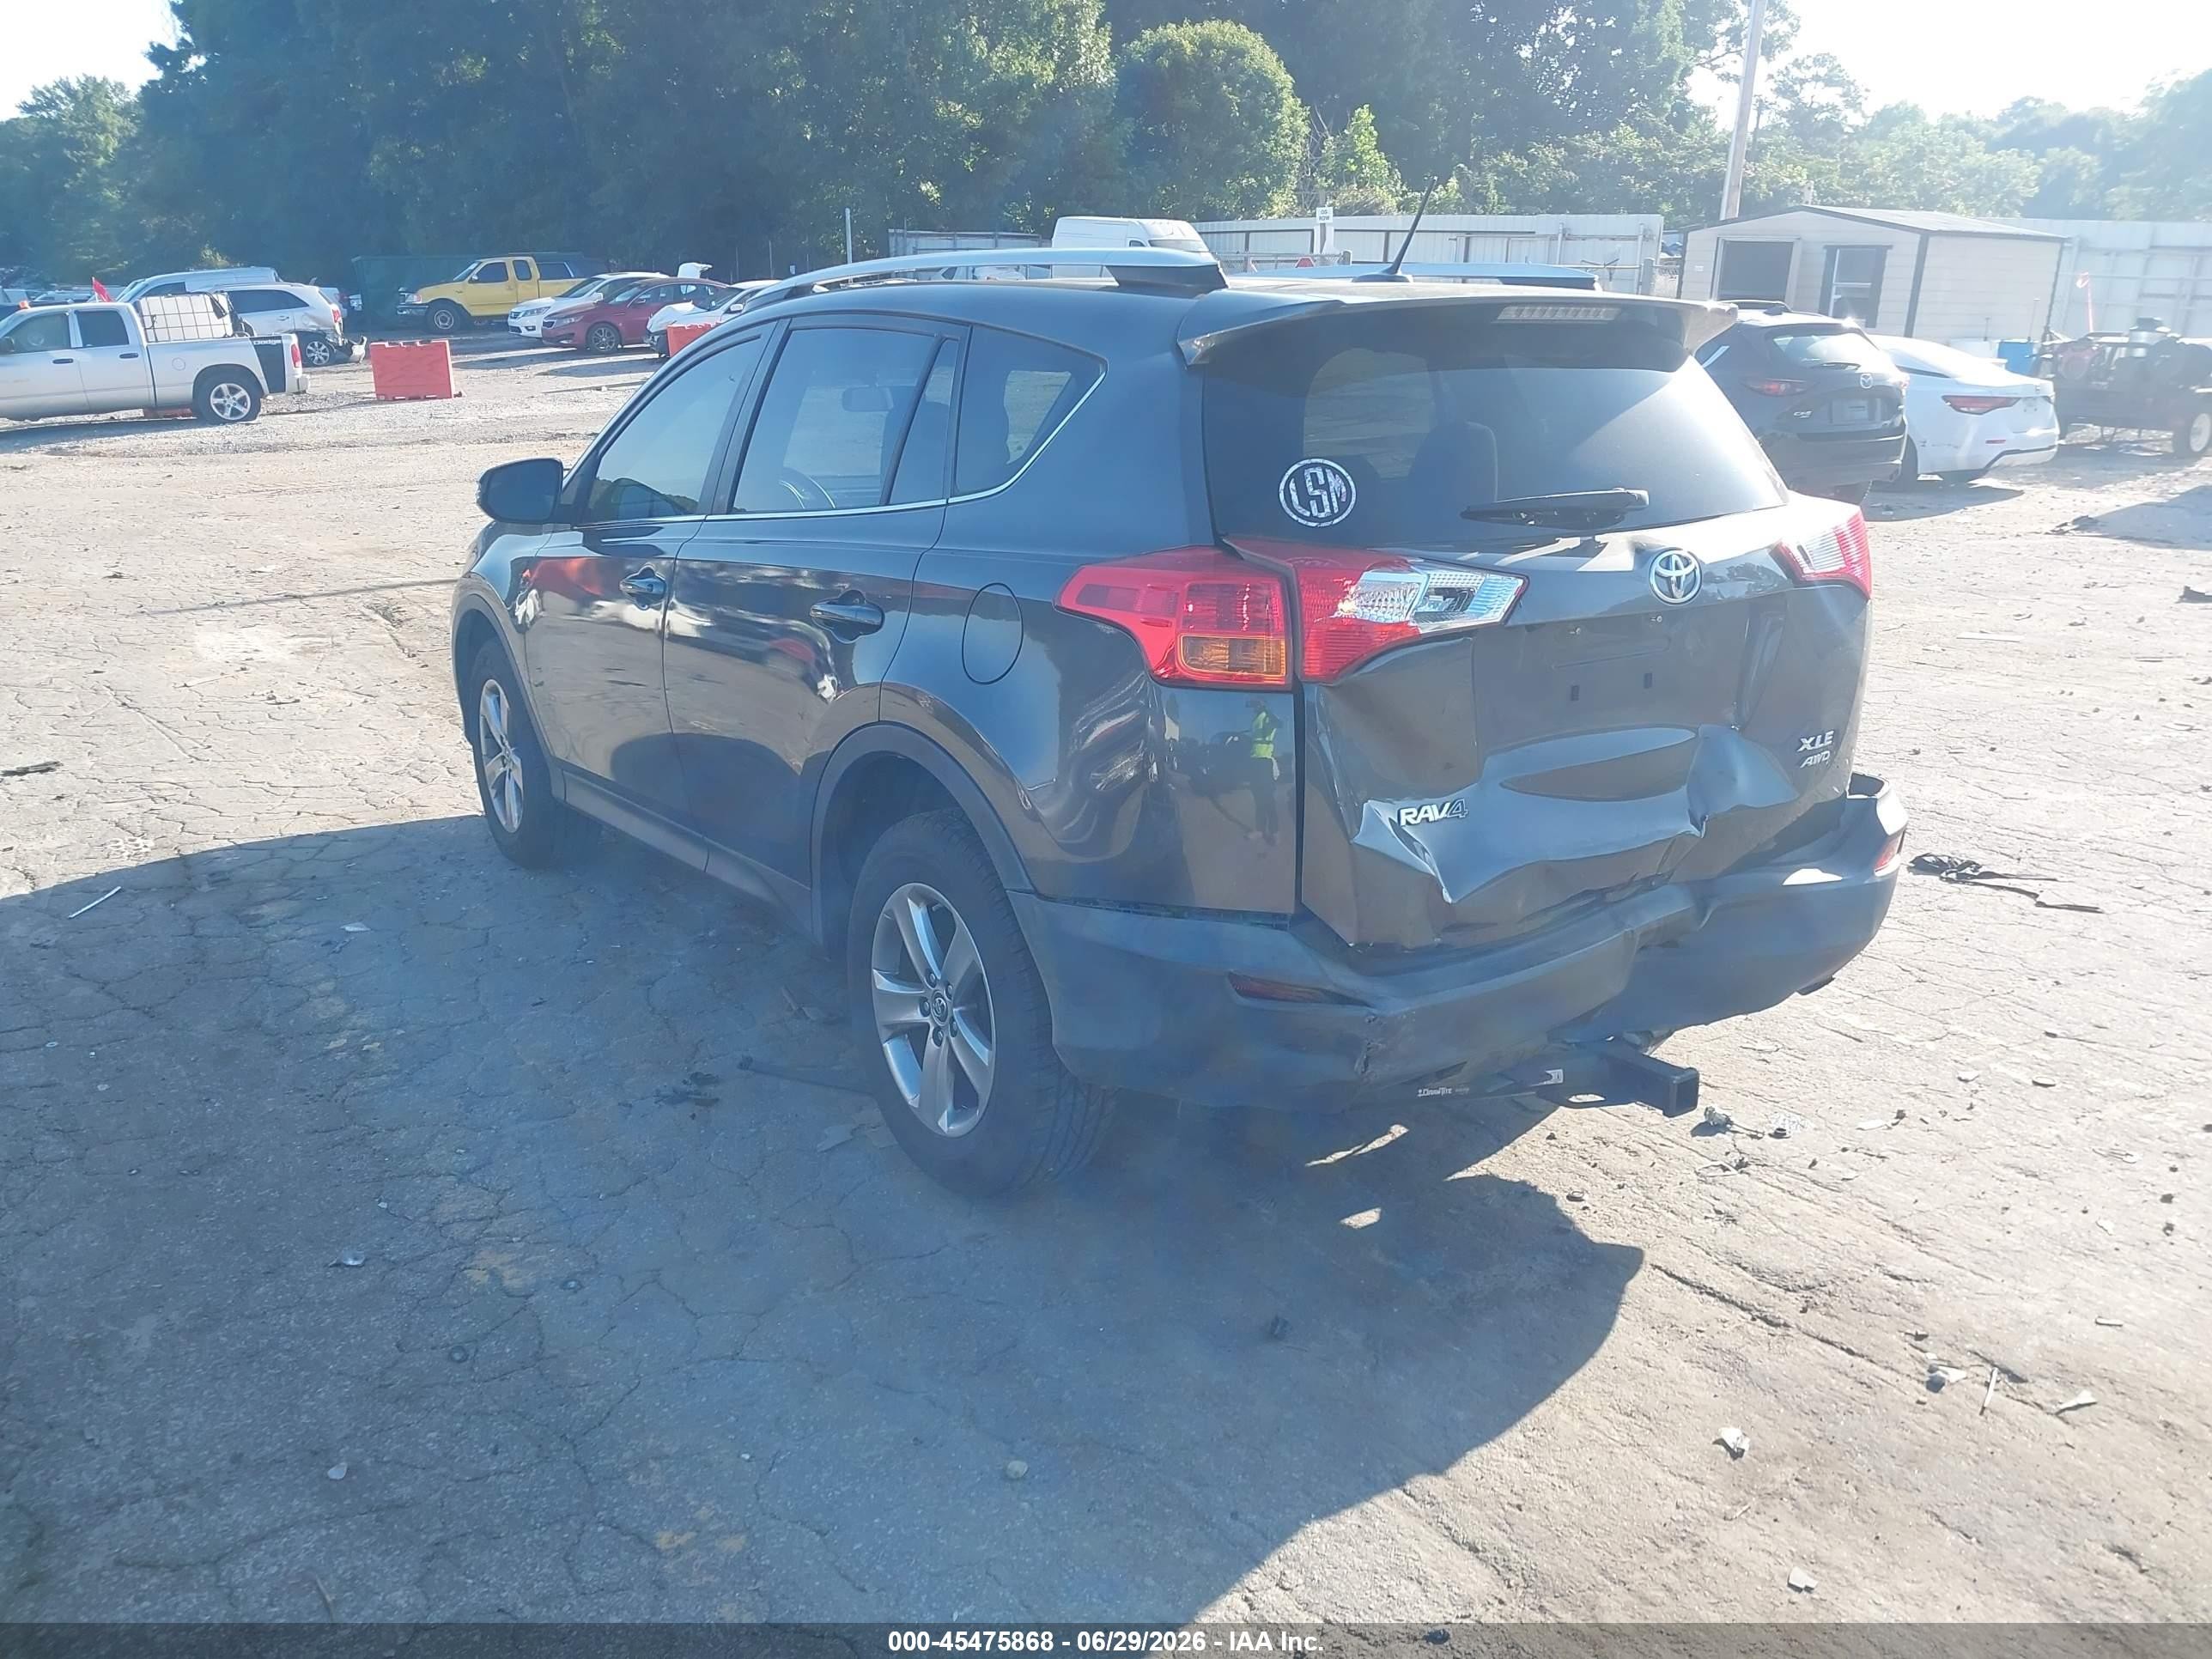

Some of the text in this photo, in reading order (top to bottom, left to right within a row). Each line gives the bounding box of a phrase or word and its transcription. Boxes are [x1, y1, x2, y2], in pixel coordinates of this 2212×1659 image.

[1289, 466, 1346, 518] LSM
[1796, 730, 1834, 752] XLE
[1800, 750, 1831, 769] AWD
[1400, 798, 1468, 827] RAV4
